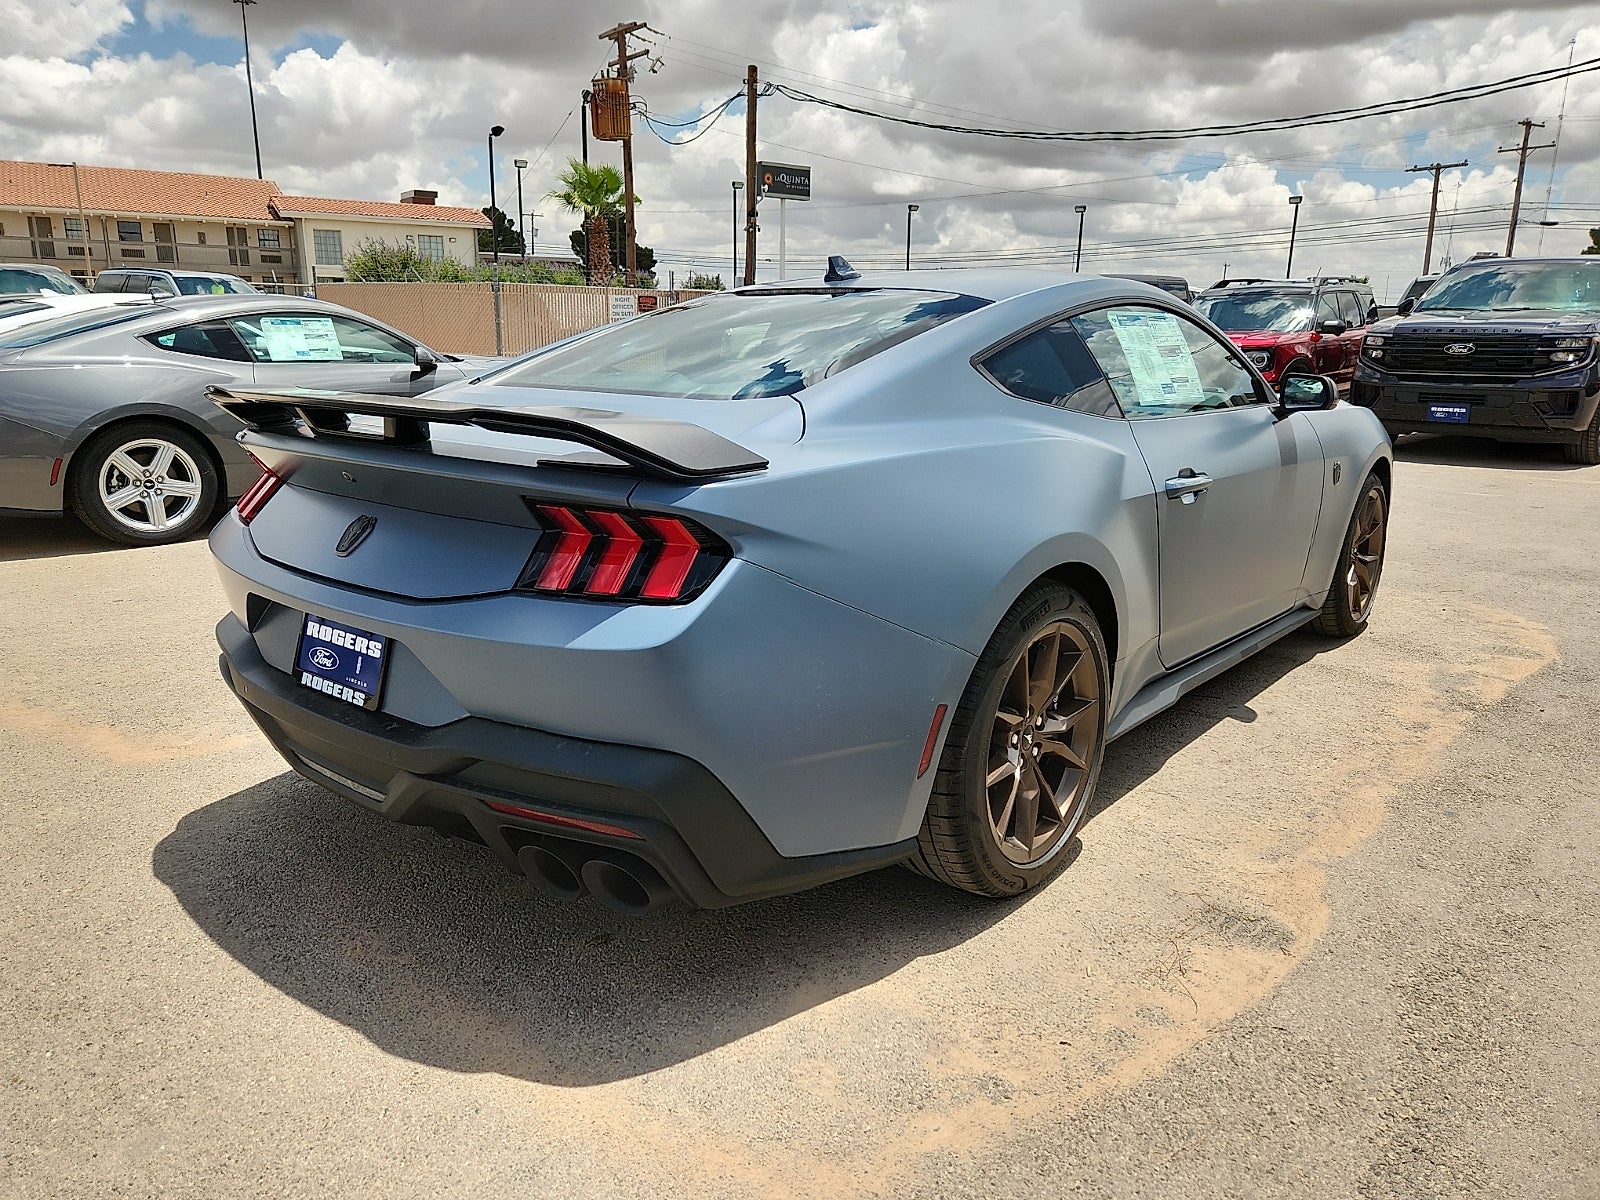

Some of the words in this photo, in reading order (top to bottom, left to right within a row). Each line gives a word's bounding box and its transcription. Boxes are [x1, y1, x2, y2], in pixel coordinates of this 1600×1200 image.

[306, 620, 383, 659] ROGERS
[312, 648, 336, 668] Ford
[301, 671, 366, 707] ROGERS
